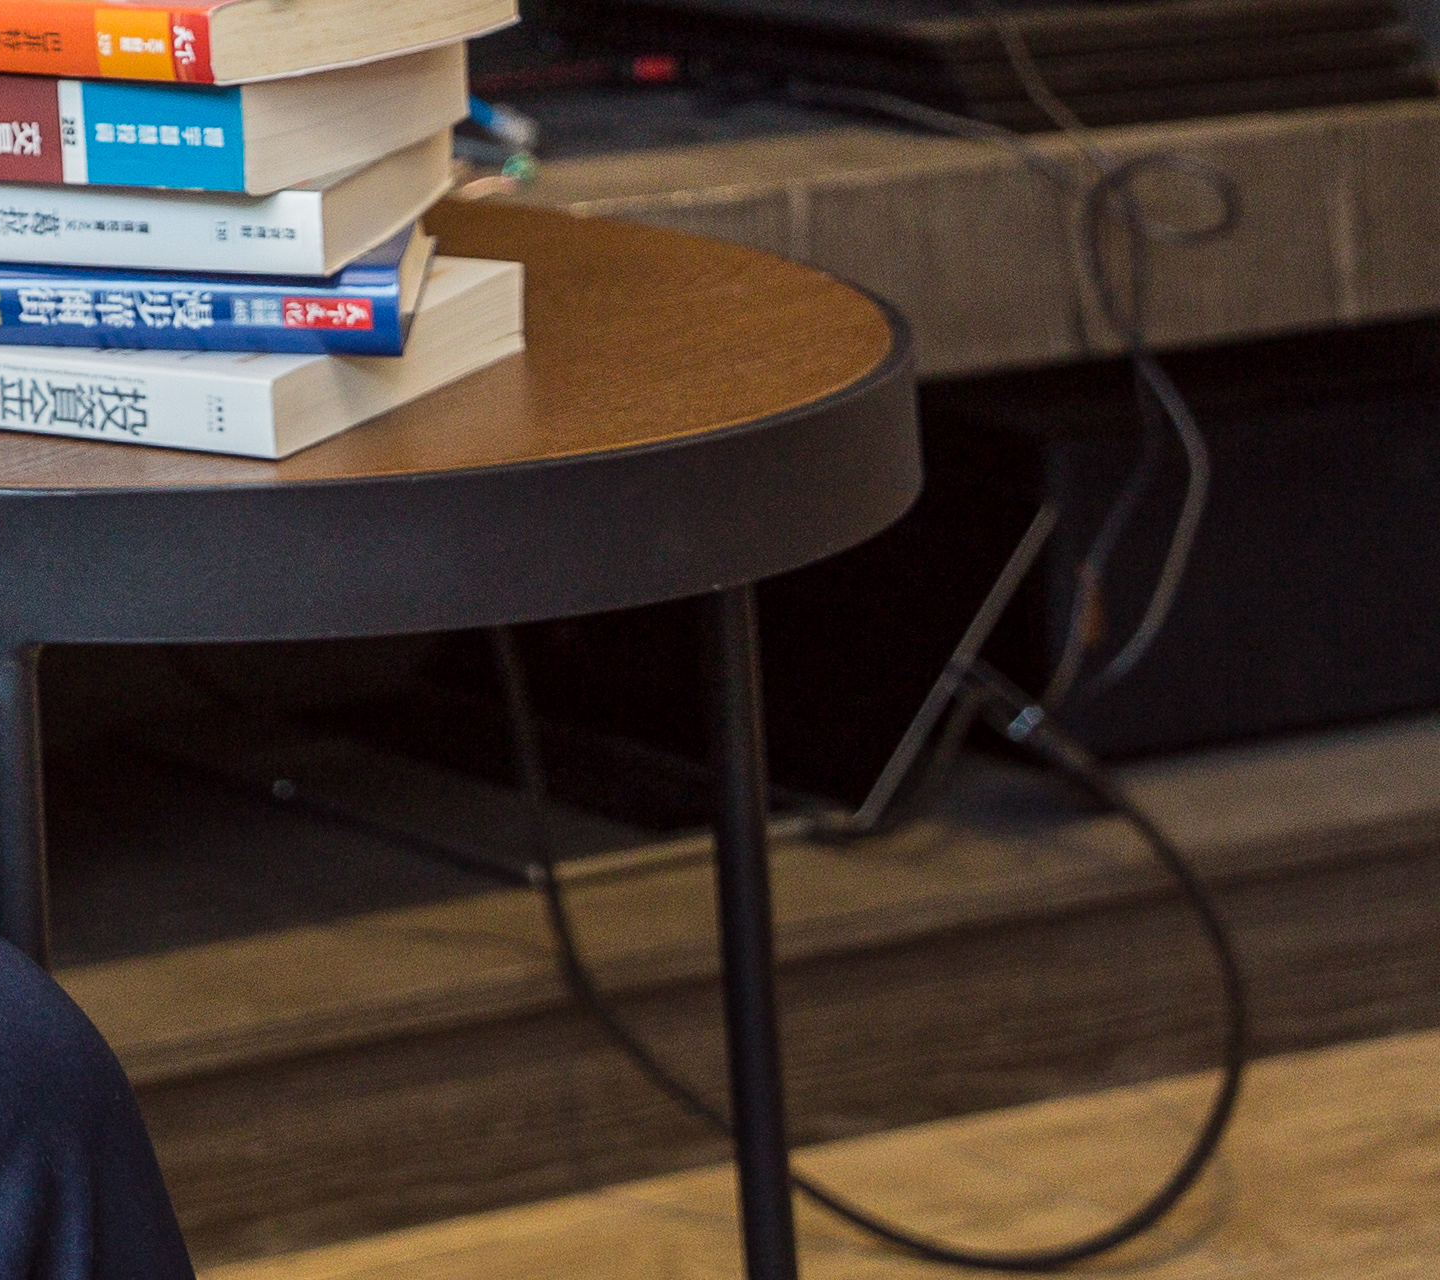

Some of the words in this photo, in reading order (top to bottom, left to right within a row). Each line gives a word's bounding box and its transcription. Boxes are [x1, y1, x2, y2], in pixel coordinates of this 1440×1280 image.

[16, 288, 213, 330] 漫步華爾街
[285, 301, 371, 327] 天下文化
